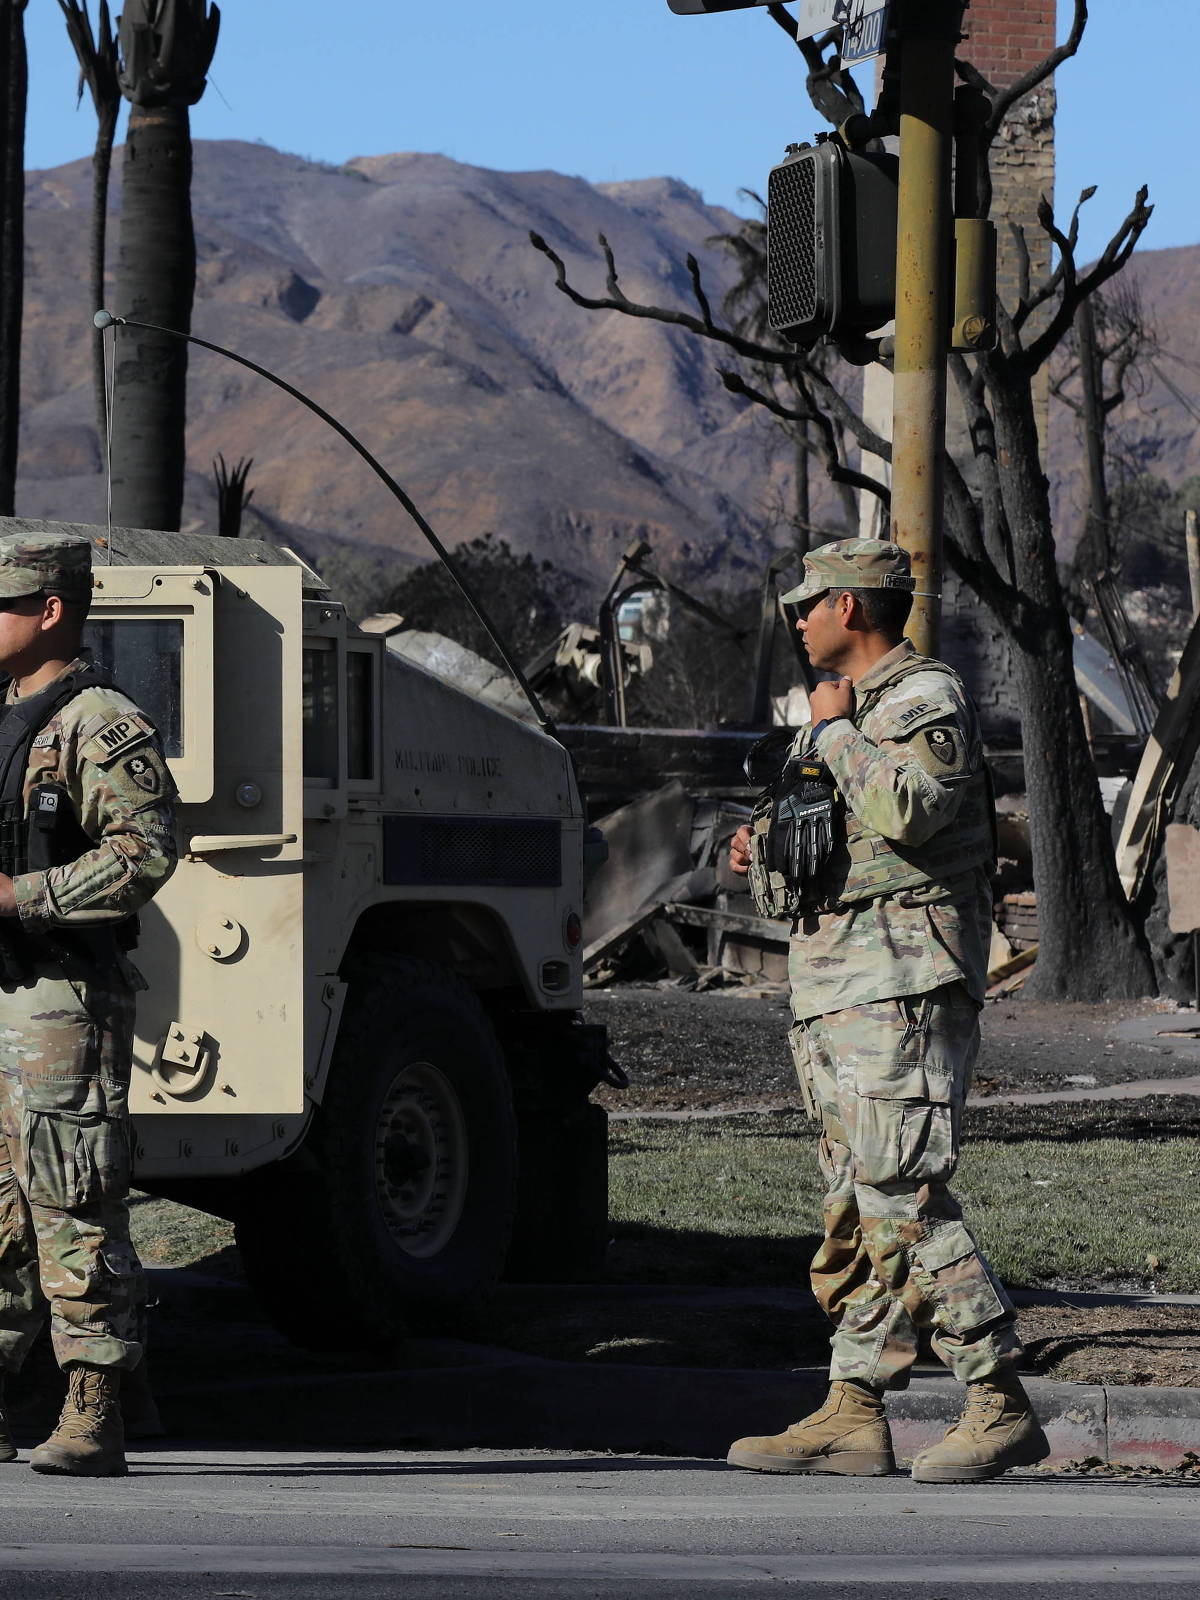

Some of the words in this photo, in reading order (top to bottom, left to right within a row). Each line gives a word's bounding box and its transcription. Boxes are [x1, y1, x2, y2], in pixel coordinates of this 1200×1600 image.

[899, 702, 929, 722] MP
[99, 721, 130, 748] MP
[40, 795, 55, 807] TQ
